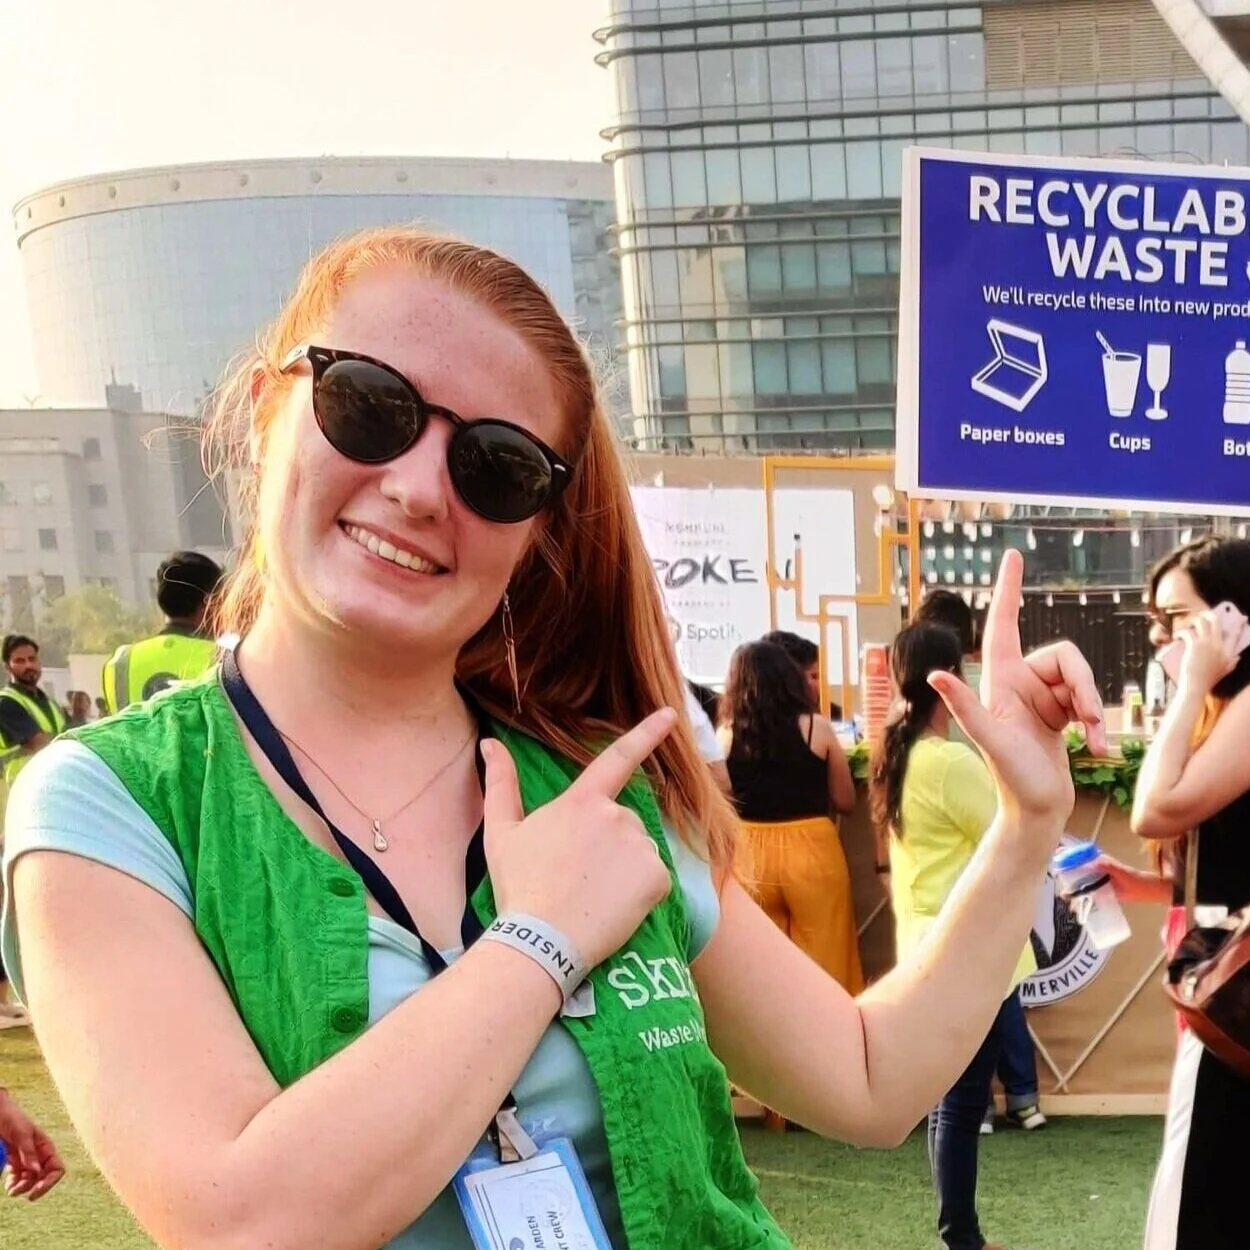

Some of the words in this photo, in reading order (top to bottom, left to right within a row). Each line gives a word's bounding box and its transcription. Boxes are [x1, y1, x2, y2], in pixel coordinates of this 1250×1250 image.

[1045, 232, 1229, 287] WASTE
[983, 285, 1024, 305] We'll
[1027, 289, 1086, 311] recycle
[1090, 292, 1135, 311] these
[1139, 295, 1171, 313] into
[1175, 300, 1209, 316] new
[960, 423, 1011, 445] Paper
[1014, 426, 1065, 446] boxes
[1109, 432, 1151, 453] Cups
[493, 920, 575, 978] INSIDER
[607, 951, 699, 1010] skr
[1022, 949, 1099, 997] MERVILLE
[639, 1021, 692, 1052] Waste
[547, 1210, 565, 1240] CREW
